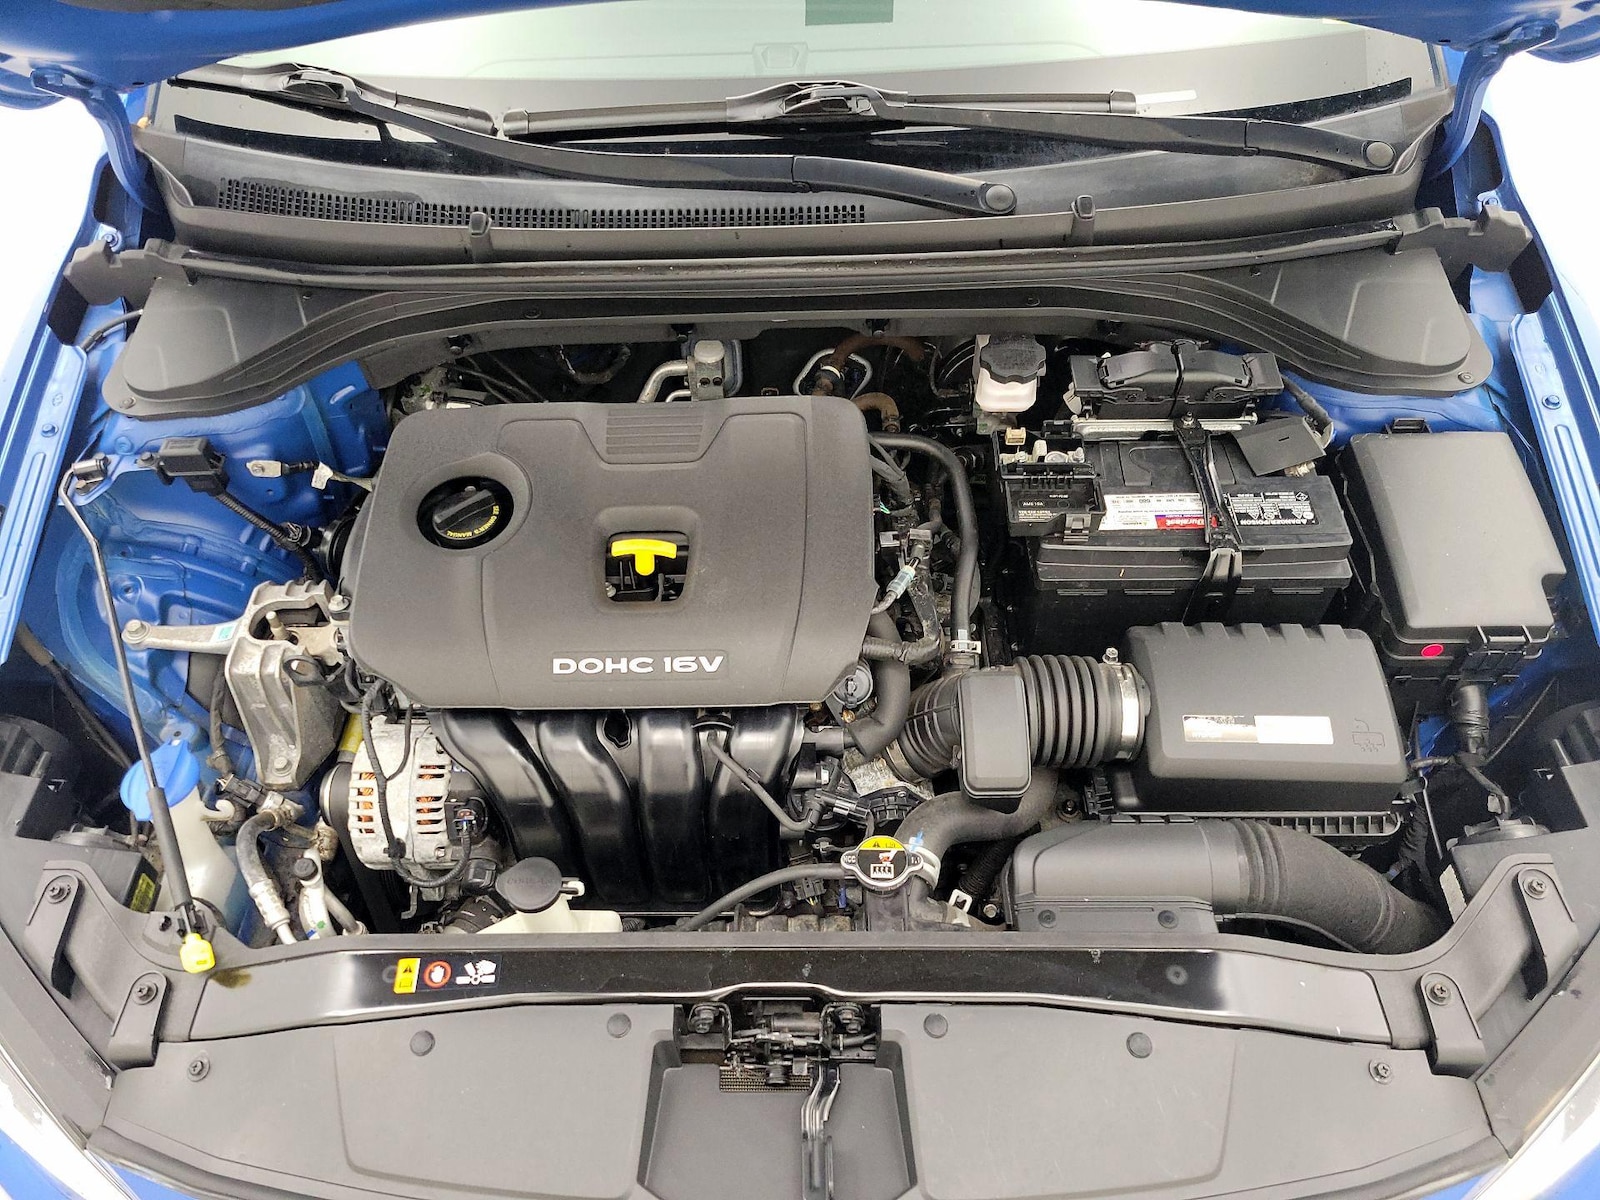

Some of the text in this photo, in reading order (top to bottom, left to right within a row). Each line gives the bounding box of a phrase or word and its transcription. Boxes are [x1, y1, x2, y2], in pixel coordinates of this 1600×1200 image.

[446, 530, 473, 538] MANUAL
[552, 656, 724, 674] DOHC 16V
